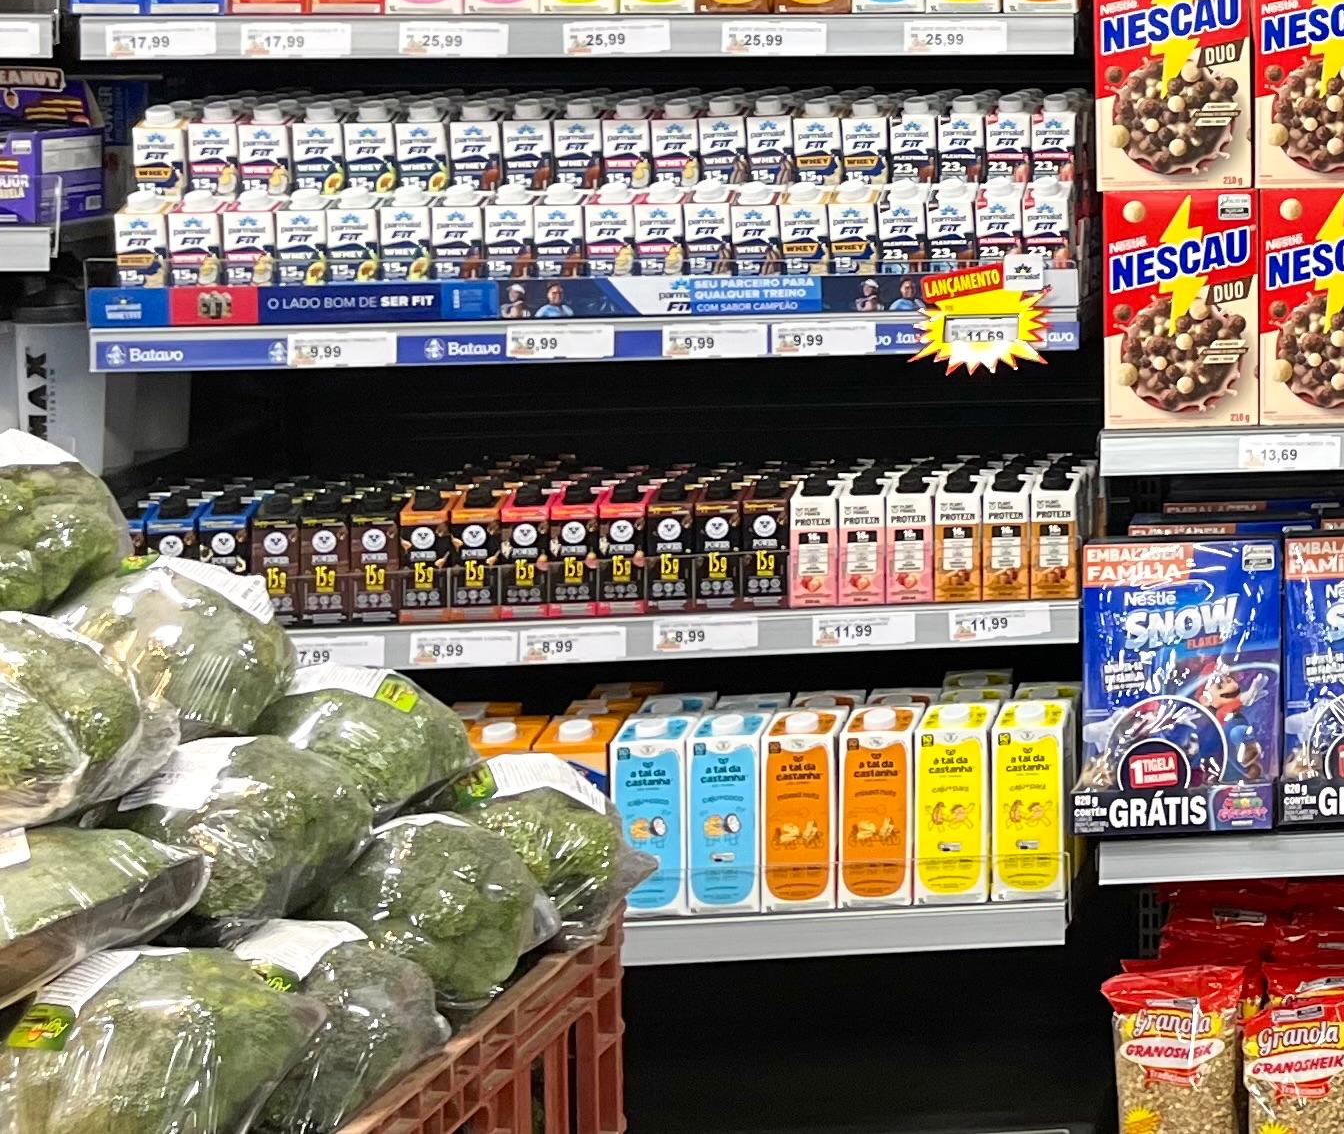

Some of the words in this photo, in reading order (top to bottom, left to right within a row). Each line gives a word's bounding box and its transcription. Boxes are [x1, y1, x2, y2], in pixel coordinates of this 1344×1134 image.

[130, 35, 170, 50] 17,99
[421, 34, 463, 48] 25,99
[925, 33, 963, 46] 25,99
[1205, 44, 1236, 64] DUO
[793, 227, 814, 236] FIT
[785, 244, 817, 252] WHEY
[1111, 227, 1249, 292] NESCAU
[694, 279, 718, 289] SEU
[721, 277, 780, 288] PARCEIRO
[783, 277, 814, 287] PARA
[925, 269, 1000, 298] LANÇAMENTO
[694, 288, 762, 300] QUALQUER
[765, 288, 805, 299] TREINO
[268, 298, 278, 309] O
[282, 298, 320, 309] LADO
[324, 297, 355, 308] BOM
[359, 297, 376, 307] DE
[381, 295, 409, 307] SER
[414, 295, 434, 306] FIT
[696, 303, 718, 312] COM
[721, 302, 754, 311] SABOR
[757, 299, 798, 311] CAMPEÃO
[526, 339, 557, 350] 9,99
[794, 334, 823, 346] 9,99
[130, 348, 183, 362] Batavo
[311, 346, 341, 359] 9,99
[448, 343, 500, 356] Batavo
[1260, 447, 1298, 462] 13,69
[844, 516, 879, 524] PROTEIN
[988, 511, 1023, 520] PROTEIN
[660, 556, 678, 573] 15g
[757, 552, 775, 570] 15g
[970, 618, 1008, 631] 11,99
[675, 631, 705, 643] 8,99
[834, 625, 871, 639] 11,99
[433, 643, 463, 656] 8,99
[1110, 790, 1207, 828] GRÁTIS
[1258, 1023, 1339, 1050] Granola
[1252, 1053, 1344, 1077] GRANOSHEIK
